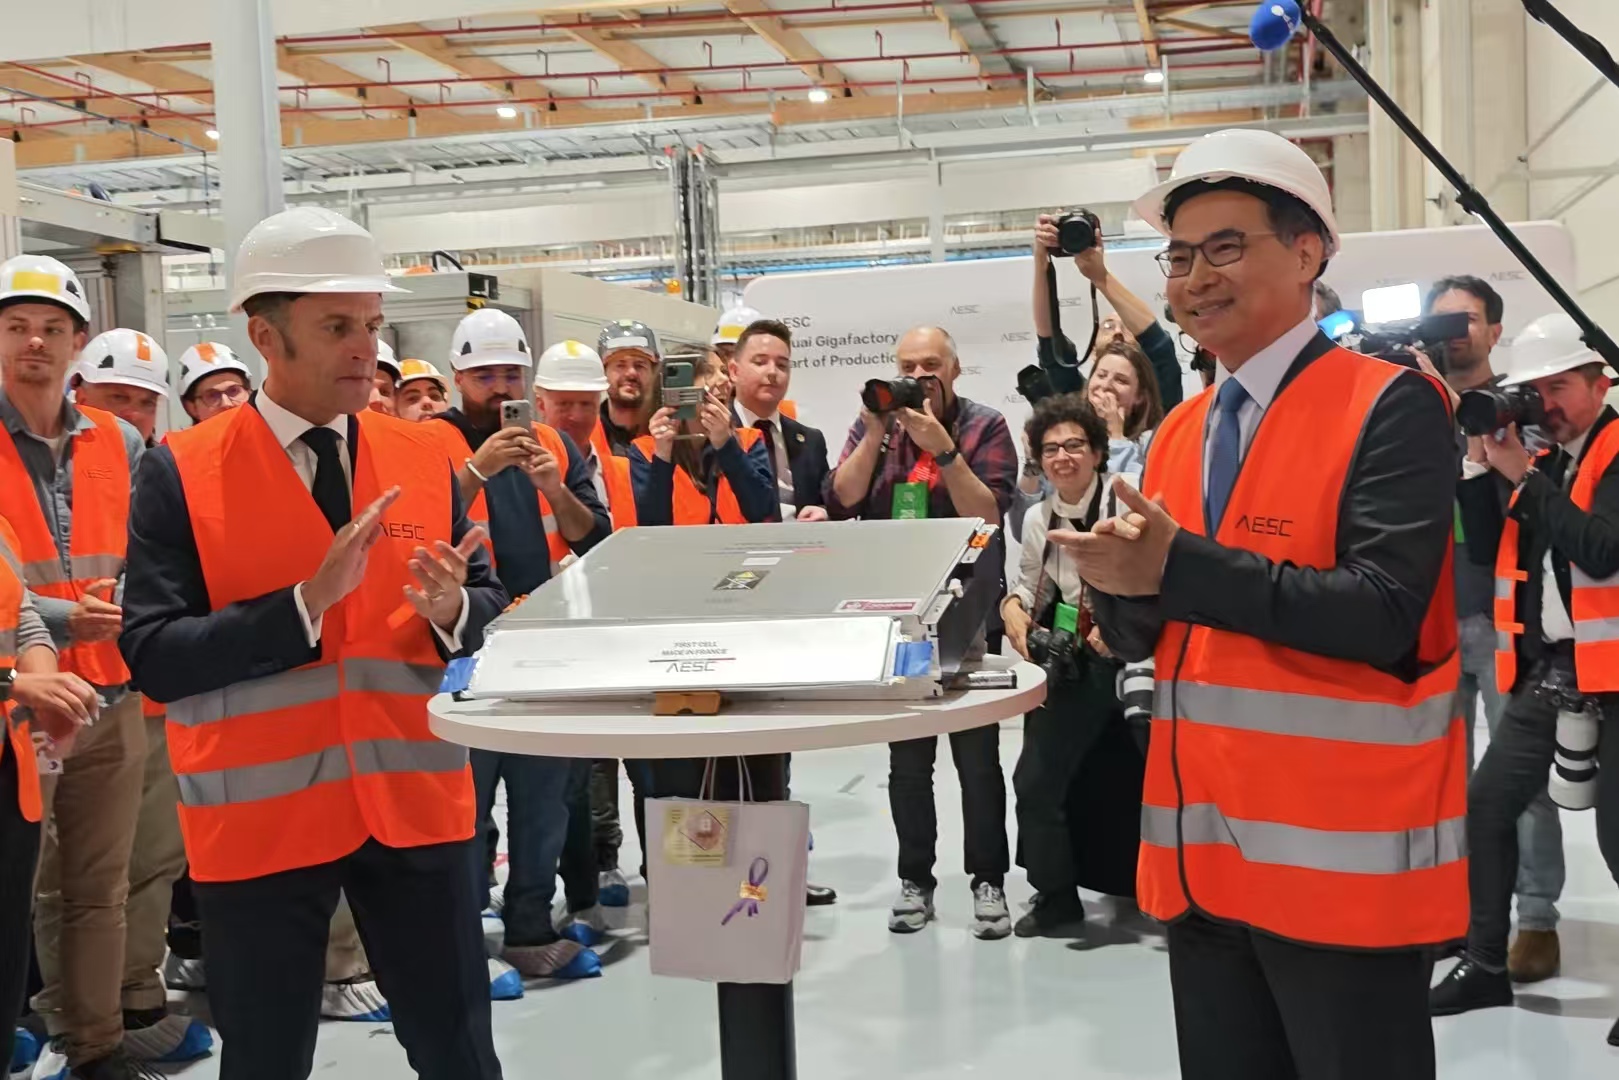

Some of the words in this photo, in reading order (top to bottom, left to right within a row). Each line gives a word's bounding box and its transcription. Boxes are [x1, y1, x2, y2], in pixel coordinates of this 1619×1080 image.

[1059, 297, 1082, 307] ESC
[791, 336, 812, 348] uai
[815, 332, 899, 350] Gigafactory
[790, 356, 809, 369] art
[812, 355, 827, 368] of
[830, 351, 897, 367] Productio
[960, 366, 984, 376] ESC
[1234, 514, 1294, 538] AESC
[665, 660, 717, 673] AESC
